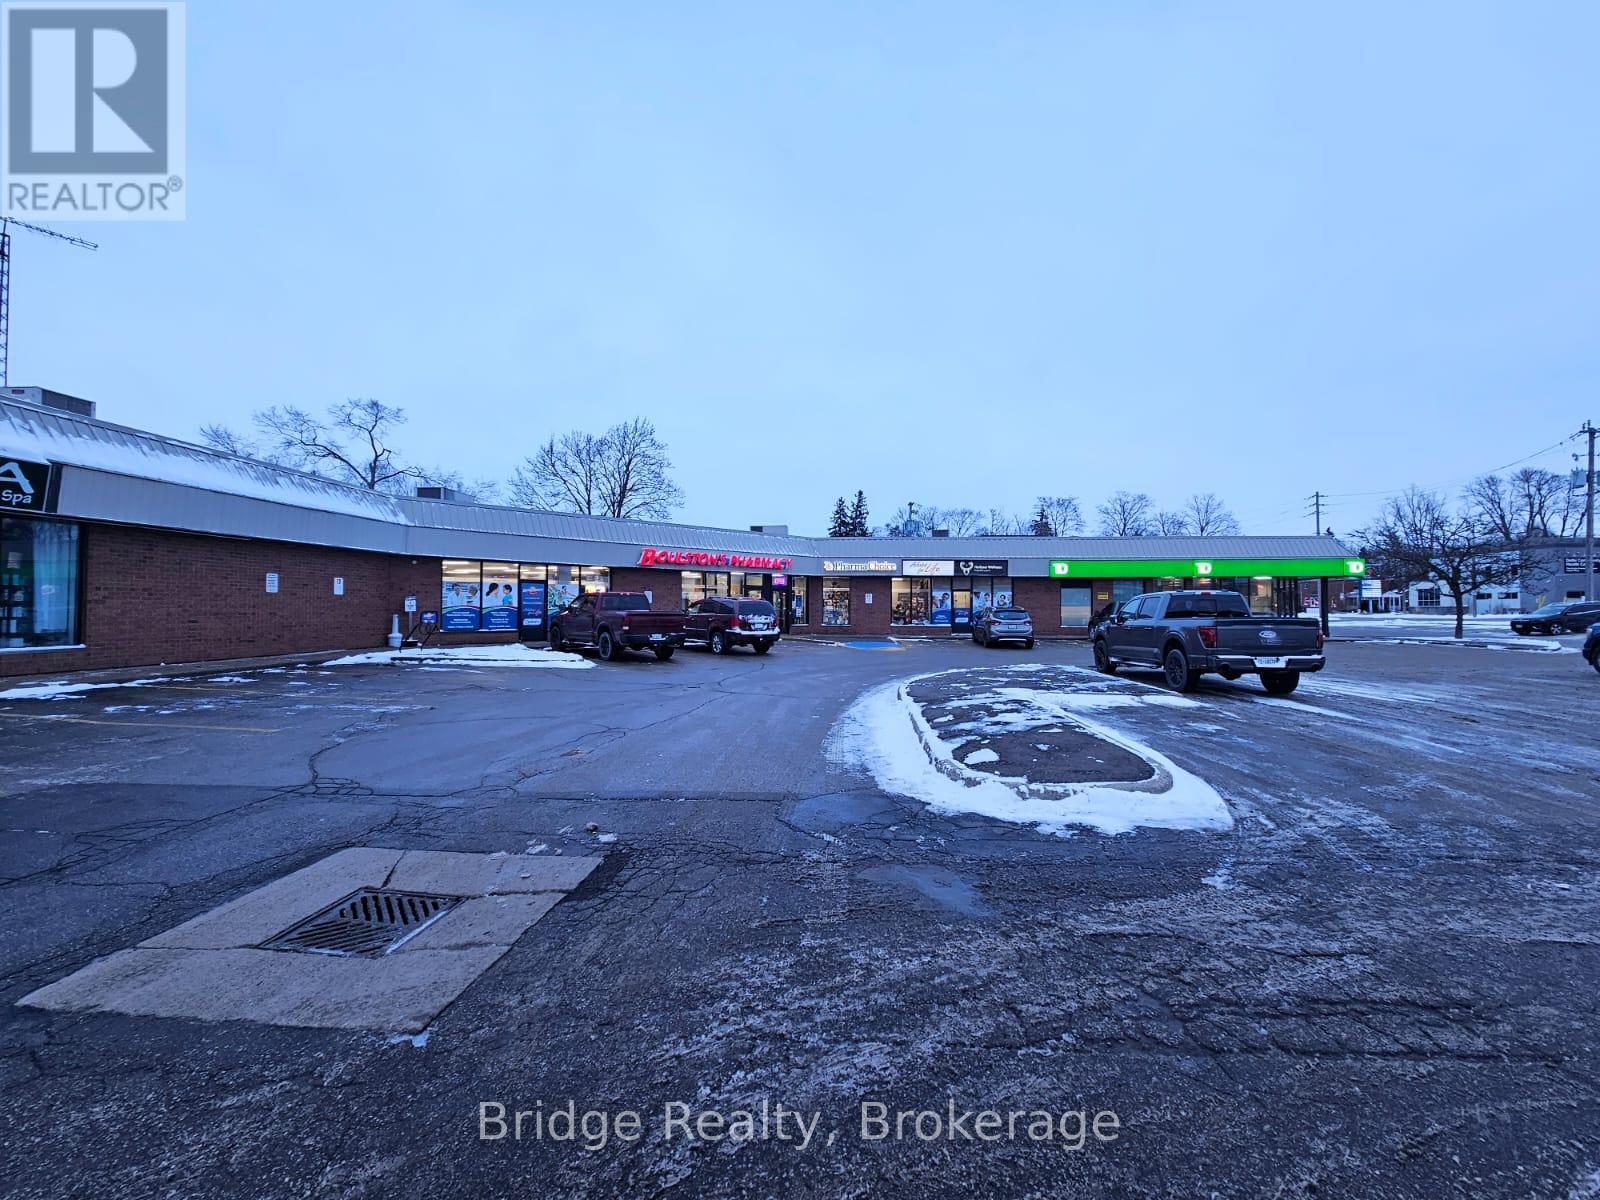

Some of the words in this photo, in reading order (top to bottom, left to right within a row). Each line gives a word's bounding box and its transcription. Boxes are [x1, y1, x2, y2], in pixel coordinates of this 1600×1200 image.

[1, 489, 32, 506] Spa
[729, 555, 793, 570] PHARMACY
[1052, 562, 1069, 576] TD
[1195, 562, 1212, 575] TD
[1346, 561, 1364, 574] TD
